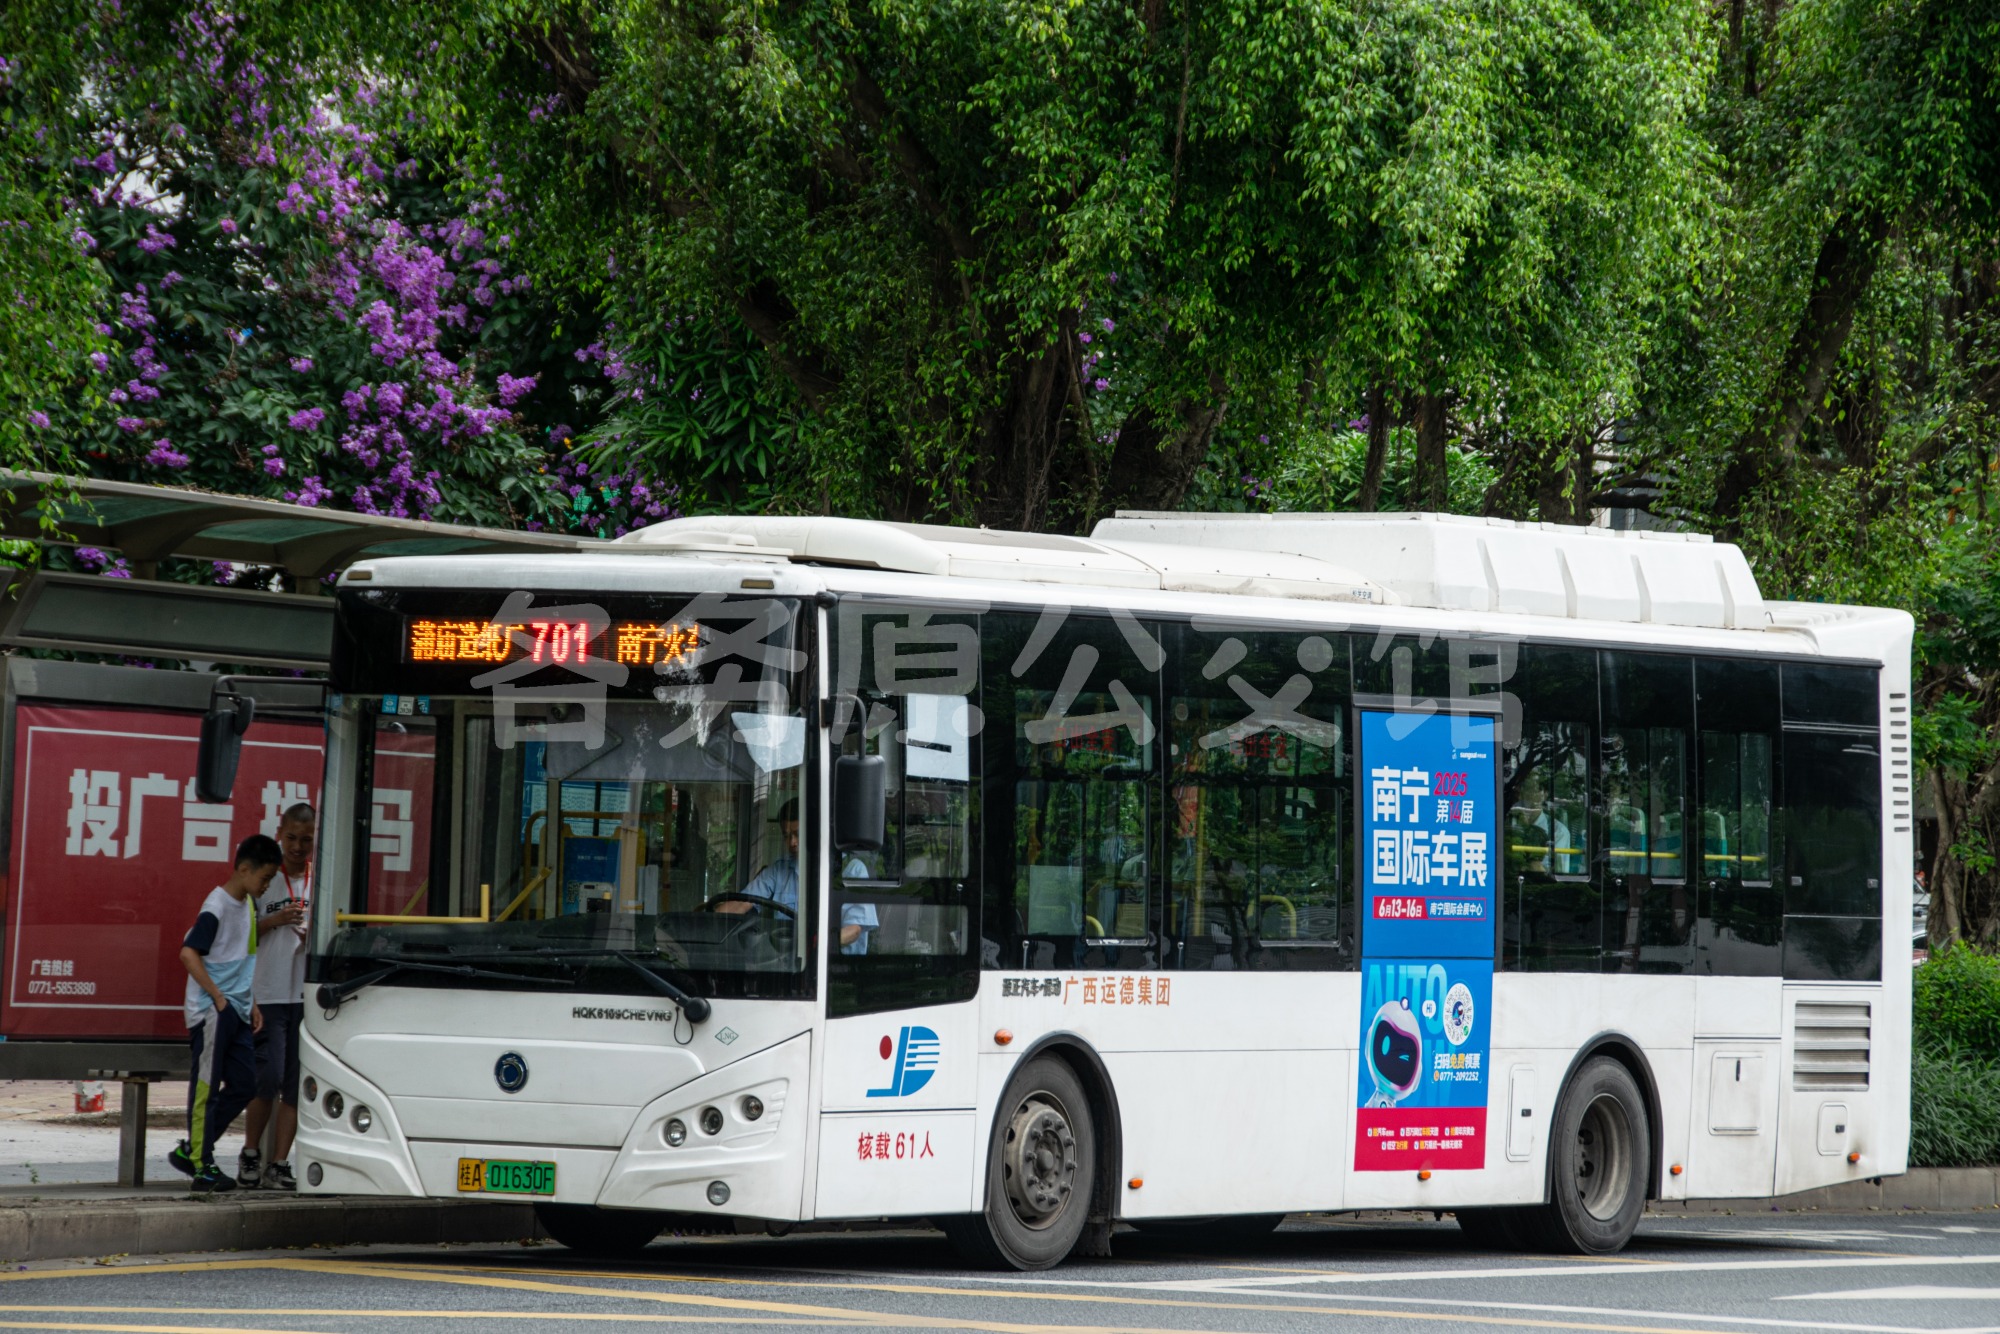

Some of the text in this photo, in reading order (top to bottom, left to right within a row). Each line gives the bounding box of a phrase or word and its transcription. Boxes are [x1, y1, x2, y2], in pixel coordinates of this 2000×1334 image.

[531, 622, 587, 662] 701
[1371, 765, 1430, 823] 南宁
[1433, 771, 1468, 797] 2025
[1436, 799, 1474, 824] 第14届
[1373, 829, 1487, 887] 国际车展
[1378, 898, 1483, 917] 6月13-16日 南宁国际会展中心
[30, 959, 74, 976] 广告热线
[28, 980, 97, 996] 0771-5853880
[1063, 975, 1171, 1007] 广西运德集团
[1434, 1053, 1481, 1069] 扫码免费领票
[857, 1130, 934, 1161] 核载61人
[460, 1163, 553, 1190] 桂A 01630F
